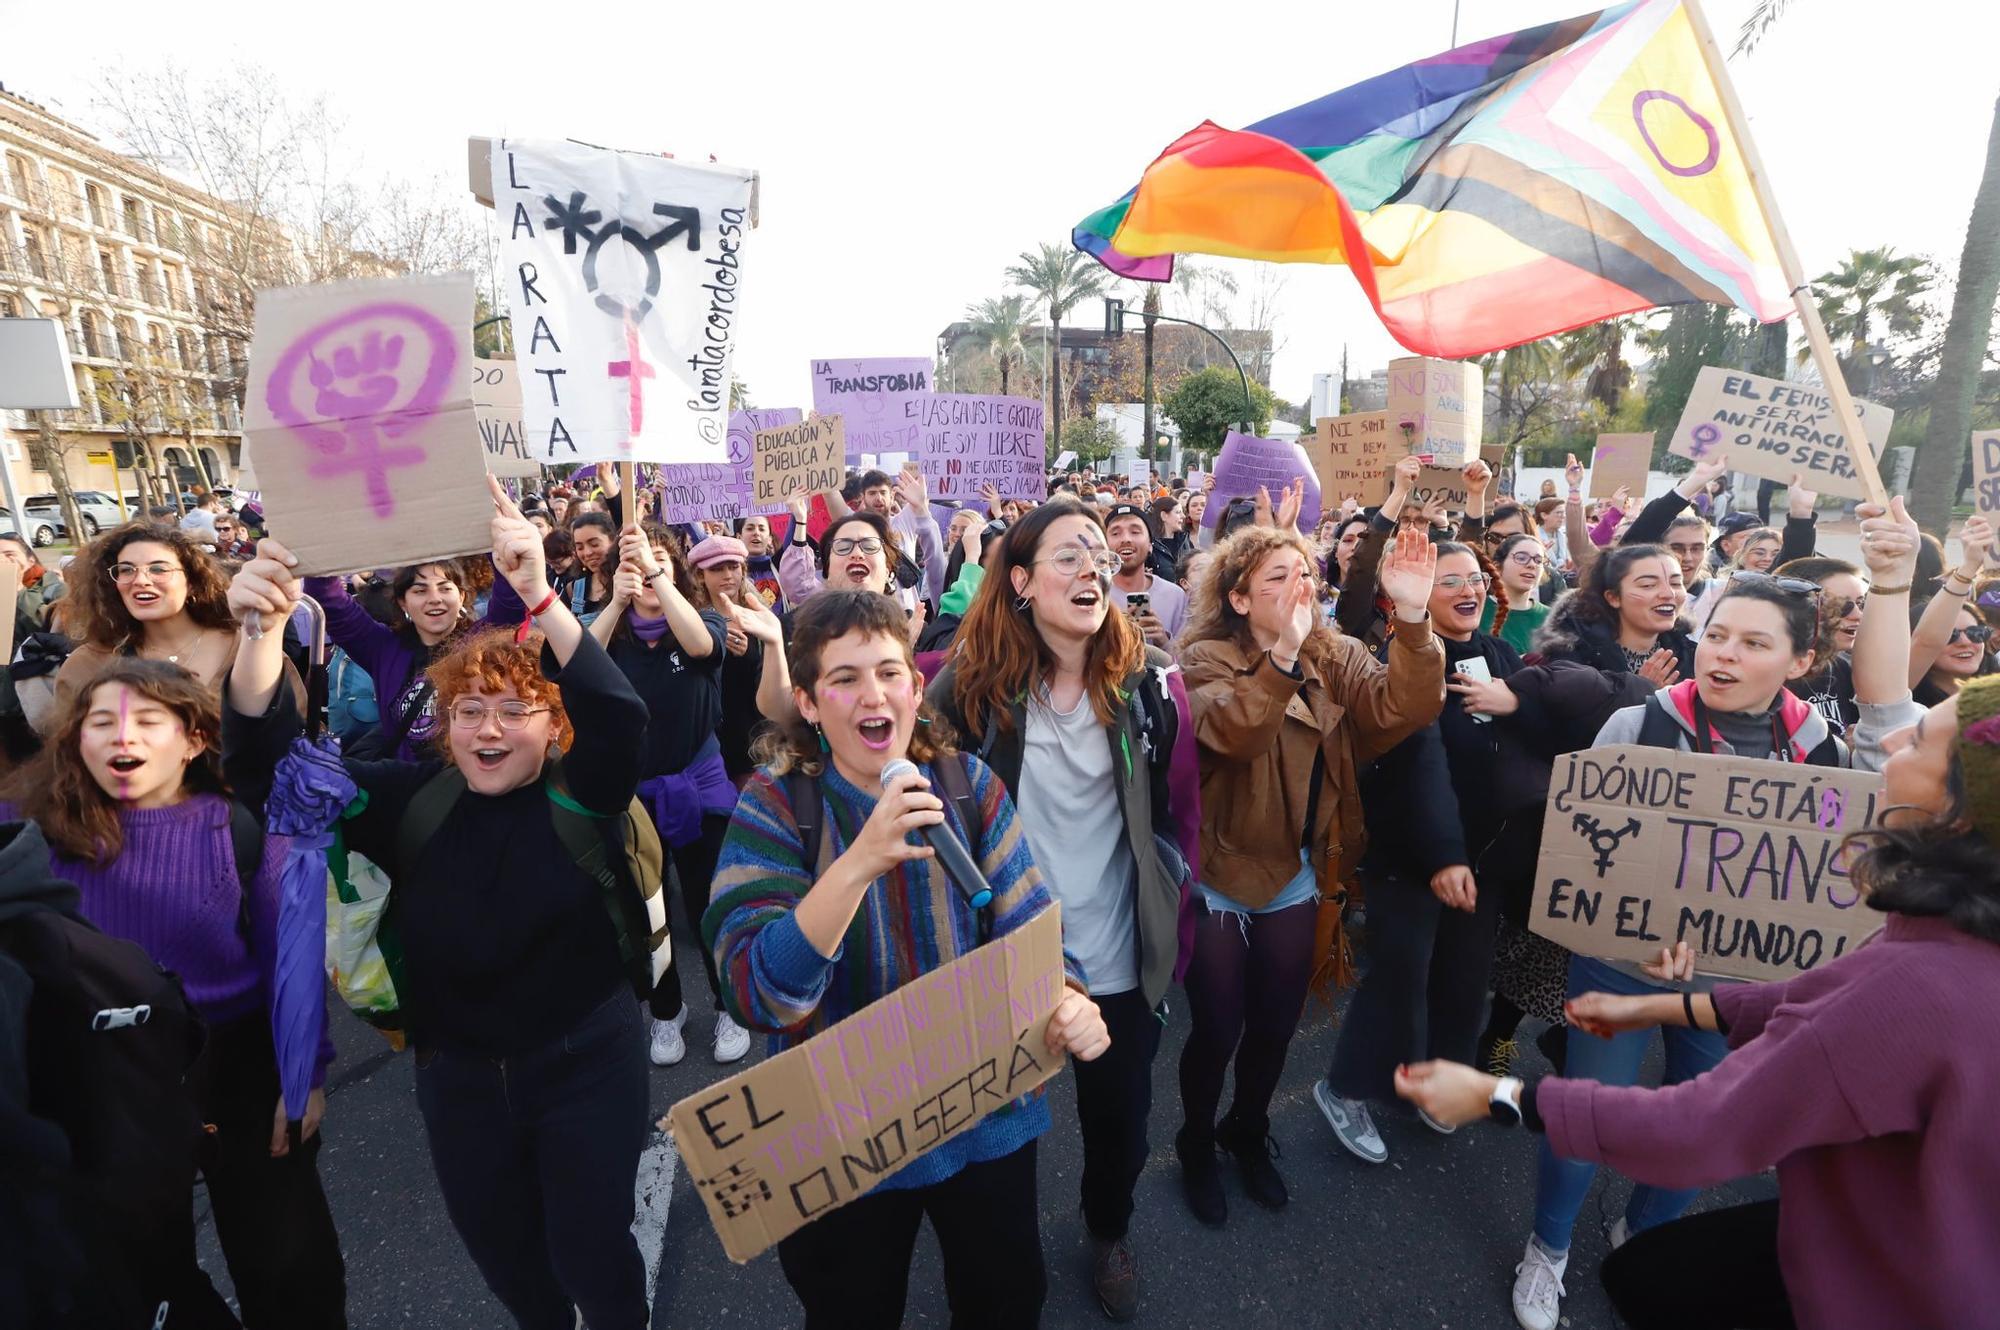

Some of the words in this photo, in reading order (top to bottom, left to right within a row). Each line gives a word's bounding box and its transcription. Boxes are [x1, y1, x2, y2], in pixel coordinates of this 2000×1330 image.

[686, 206, 746, 445] @laratacordobesa
[518, 262, 577, 456] RATA
[816, 361, 832, 375] LA
[825, 370, 926, 394] TRANSFOBIA
[1392, 370, 1426, 397] NO
[1723, 376, 1761, 401] EL
[922, 399, 949, 427] LAS
[990, 403, 1004, 424] DE
[756, 421, 819, 453] EDUCACIÓN
[845, 424, 919, 452] MINISTA
[1330, 422, 1352, 438] NI
[1713, 409, 1876, 459] ANTIRRACI
[1735, 433, 1752, 446] O
[1757, 437, 1790, 455] NO
[764, 446, 818, 472] PÚBLICA
[824, 441, 835, 461] Y
[926, 431, 951, 454] QUE
[956, 431, 977, 454] SOY
[989, 431, 1037, 459] LIBRE
[921, 460, 939, 475] QUE
[946, 459, 962, 475] NO
[966, 460, 980, 474] ME
[665, 485, 705, 505] MOTIVOS
[759, 480, 774, 499] DE
[939, 476, 957, 494] NO
[963, 477, 979, 493] ME
[1014, 477, 1041, 494] NADA
[711, 502, 740, 520] LUCHO
[1555, 753, 1697, 812] ¿DÓNDE
[1667, 816, 1869, 910] TRANS
[1547, 878, 1602, 926] EN
[1615, 896, 1661, 941] EL
[696, 1084, 784, 1150] EL
[790, 1166, 838, 1218] O
[841, 1118, 907, 1190] NO
[915, 1029, 1042, 1152] SERÁ
